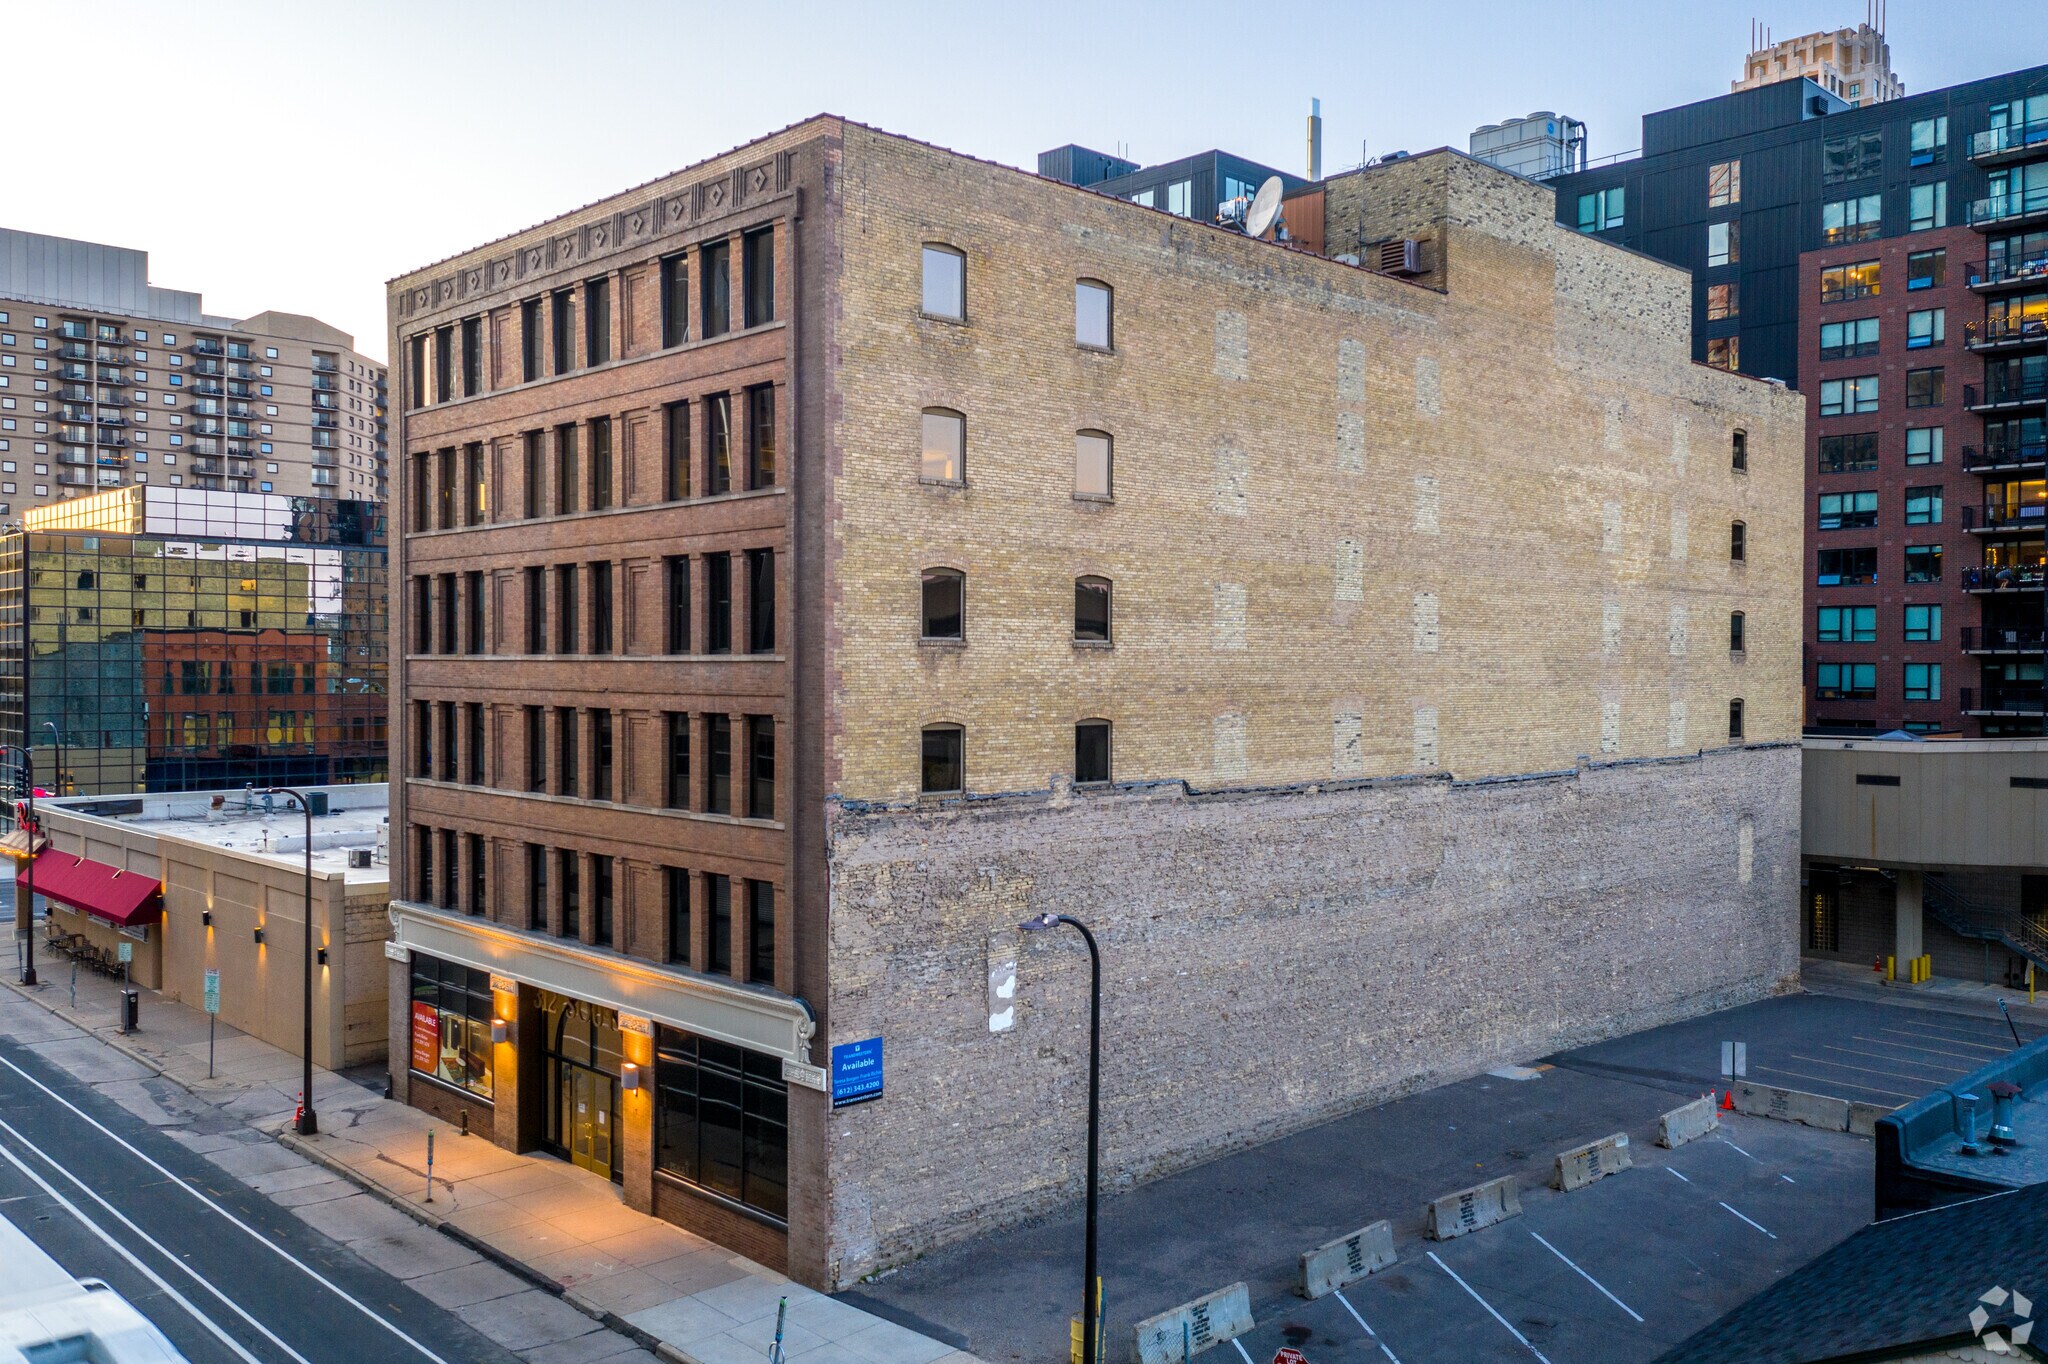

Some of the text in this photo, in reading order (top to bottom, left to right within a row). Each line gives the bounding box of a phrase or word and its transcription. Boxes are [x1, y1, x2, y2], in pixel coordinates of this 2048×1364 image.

[415, 1012, 436, 1027] AVAILABLE
[841, 1058, 875, 1071] Available
[836, 1086, 853, 1096] (612)
[1280, 1350, 1303, 1362] PRIVATE
